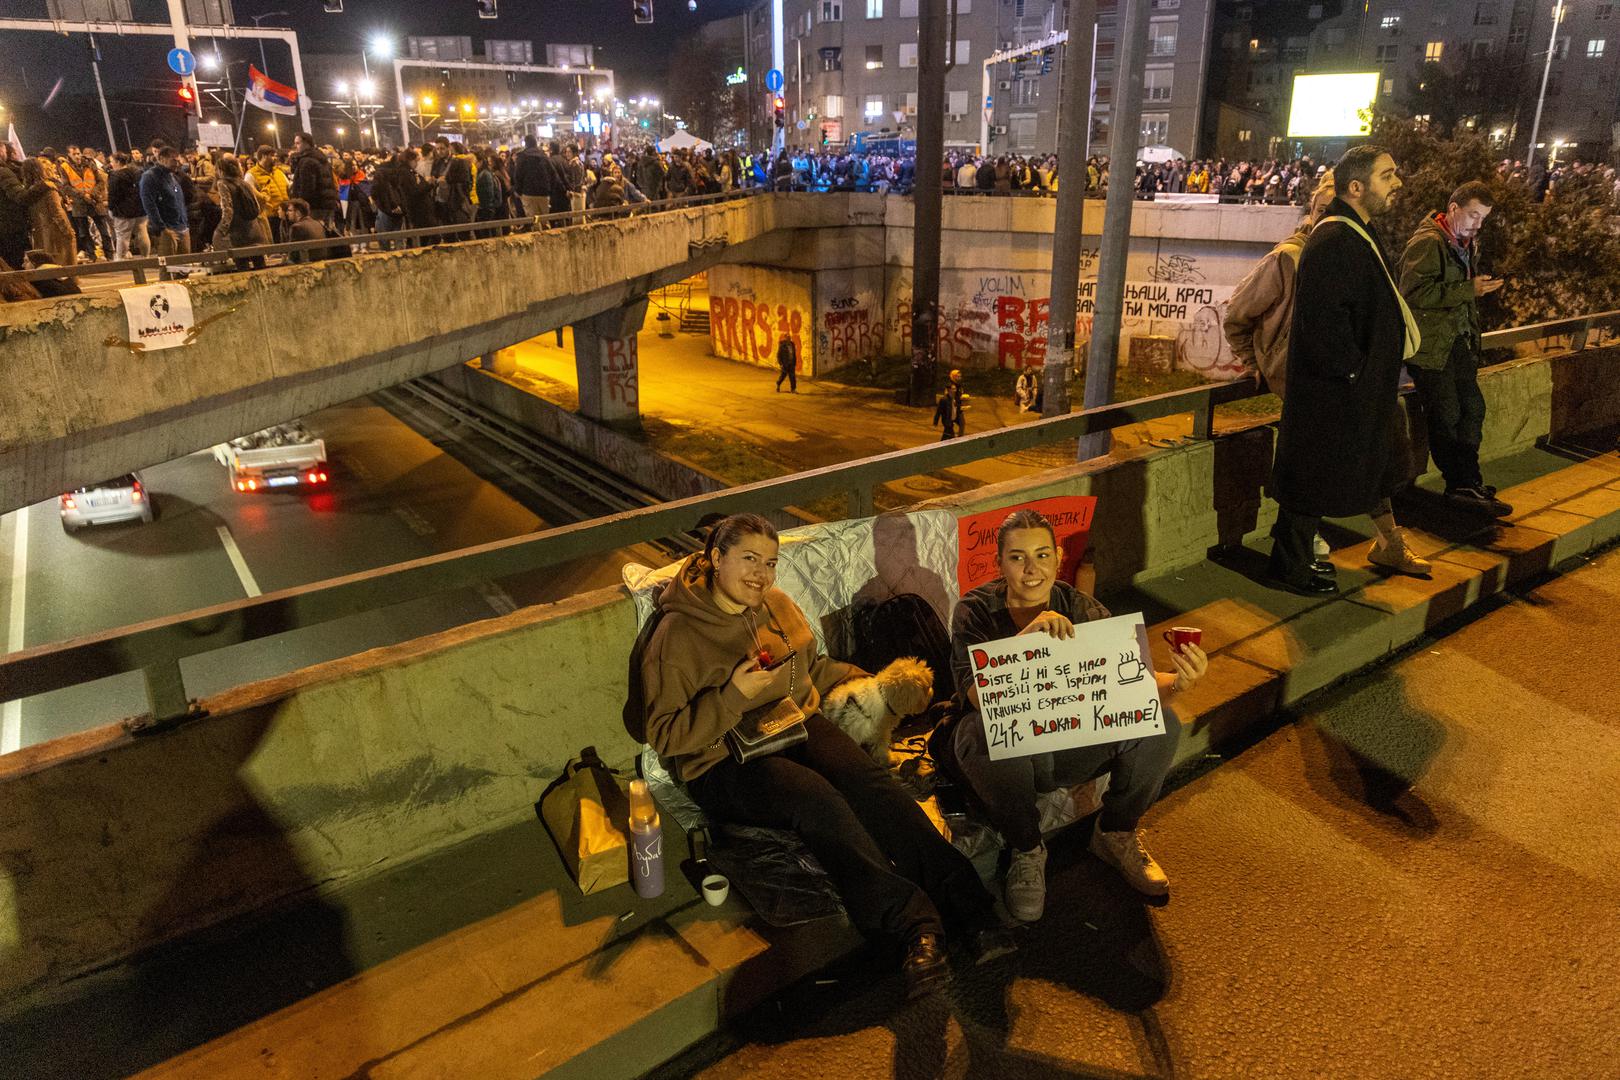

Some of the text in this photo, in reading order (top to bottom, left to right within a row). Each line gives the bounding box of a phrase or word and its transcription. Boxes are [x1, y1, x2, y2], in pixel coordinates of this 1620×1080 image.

[980, 275, 1026, 297] VOLIM
[1176, 287, 1213, 305] КРАЈ
[1148, 303, 1187, 320] МОРА
[1023, 647, 1051, 662] DAN
[1054, 663, 1071, 676] SE
[1078, 657, 1107, 673] MALO
[1033, 681, 1059, 693] DOK
[1038, 693, 1085, 711] ESPRESSO
[1091, 689, 1107, 702] NA
[989, 718, 1024, 748] 24h
